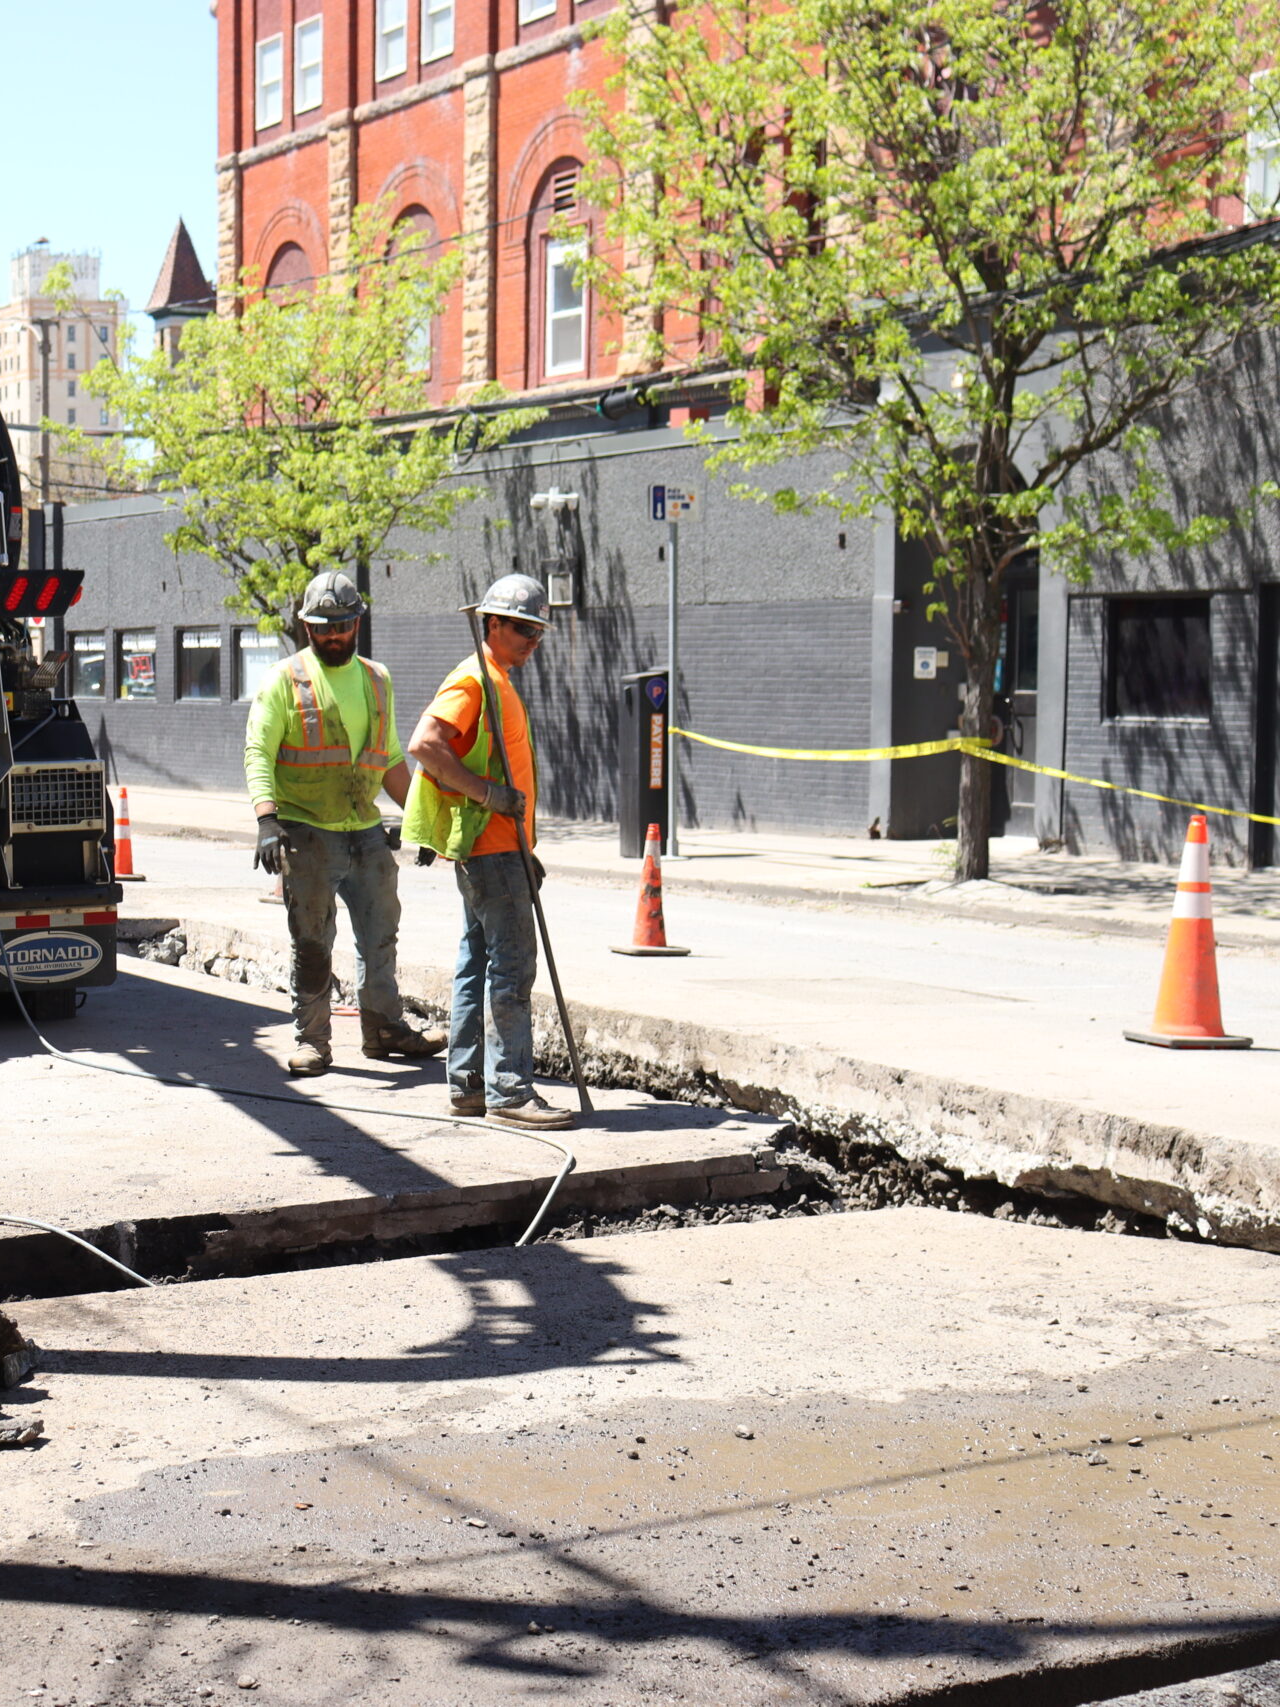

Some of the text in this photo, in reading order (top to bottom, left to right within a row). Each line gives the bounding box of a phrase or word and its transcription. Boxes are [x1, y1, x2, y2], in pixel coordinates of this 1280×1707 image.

[650, 715, 663, 786] PAY HERE
[6, 945, 92, 964] TORNADO
